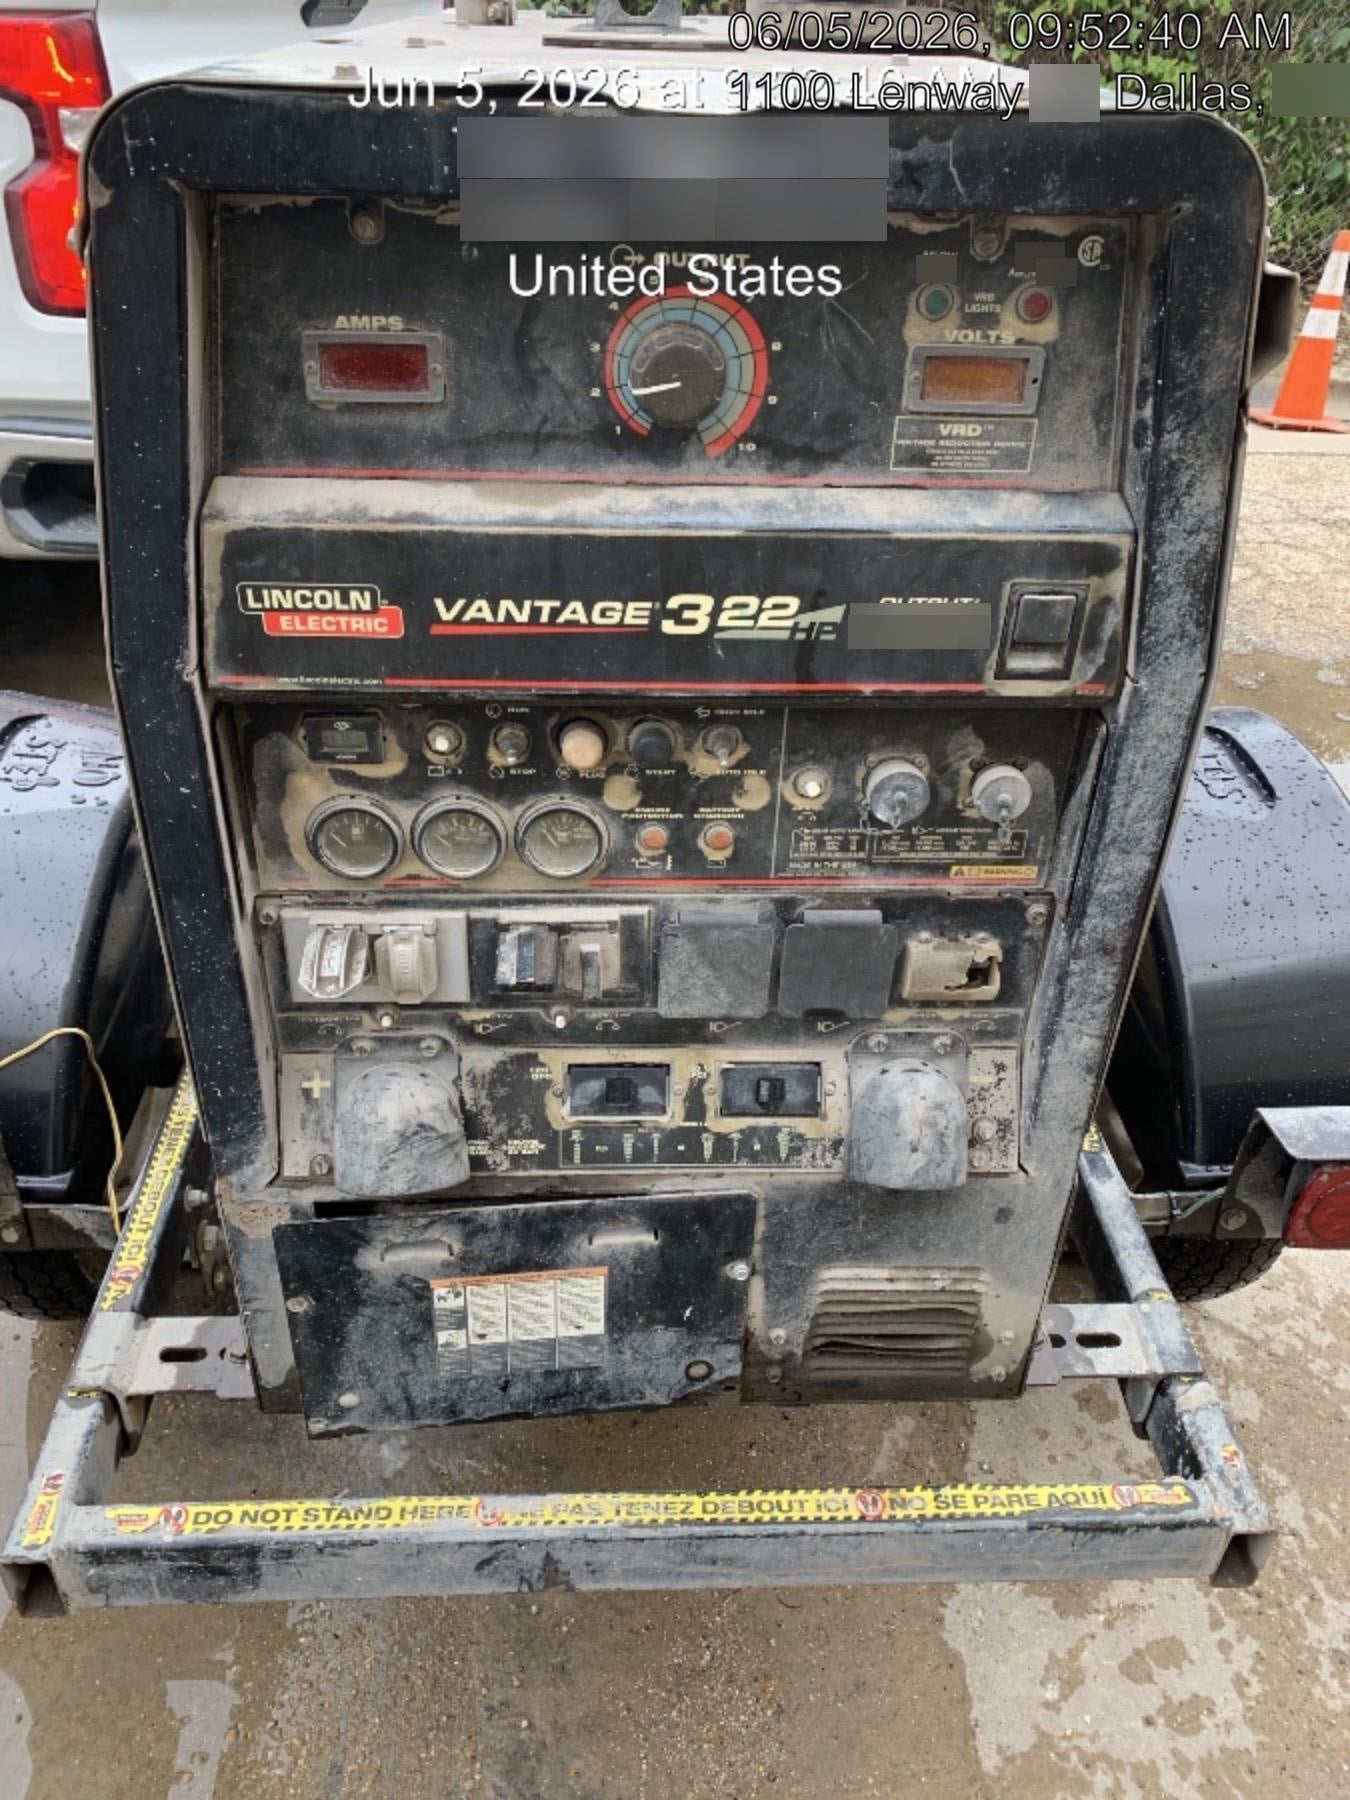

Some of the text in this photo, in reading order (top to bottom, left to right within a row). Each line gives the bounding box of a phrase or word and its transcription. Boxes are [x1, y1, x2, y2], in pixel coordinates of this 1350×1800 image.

[965, 303, 1001, 313] LIGHTS
[335, 315, 404, 331] AMPS
[945, 329, 1015, 344] VOLTS
[738, 442, 757, 452] 10
[245, 588, 373, 612] LINCOLN
[433, 597, 653, 626] VANTAGE
[661, 594, 801, 636] 322
[279, 615, 389, 633] ELECTRIC
[702, 1499, 809, 1515] DEBOUT
[889, 1496, 926, 1511] NO
[935, 1493, 970, 1511] SE
[974, 1493, 1041, 1510] PARE
[192, 1511, 233, 1525] DO
[240, 1508, 298, 1525] NOT
[303, 1505, 392, 1523] STAND
